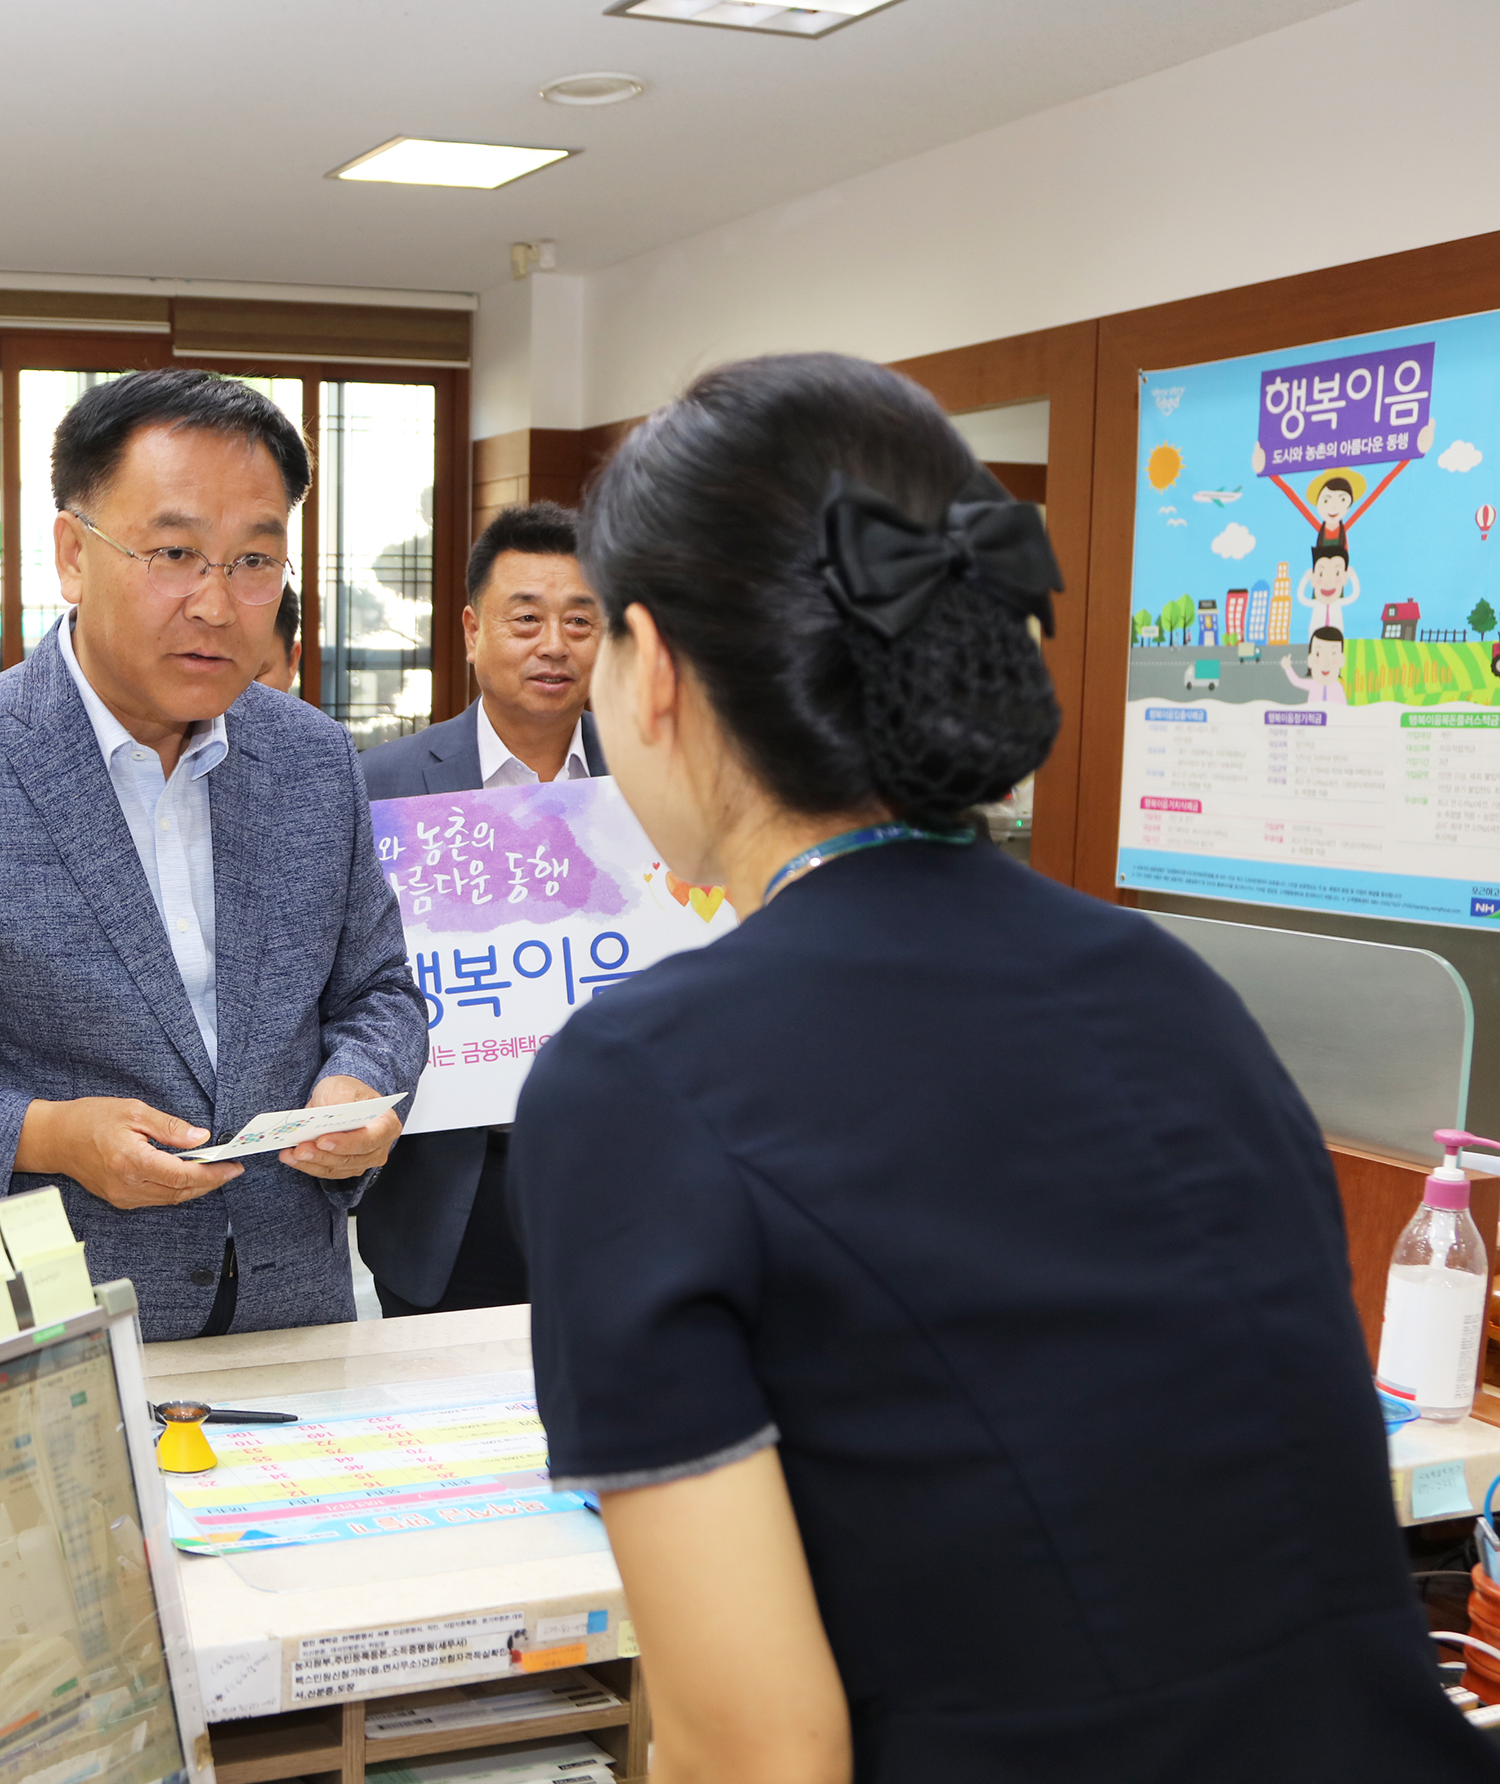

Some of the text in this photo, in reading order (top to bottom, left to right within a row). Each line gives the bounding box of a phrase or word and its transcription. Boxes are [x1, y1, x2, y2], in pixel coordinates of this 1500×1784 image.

[1265, 360, 1429, 440] 행복이음
[1272, 432, 1409, 465] 도시와 농촌의 아름다운 동행
[416, 806, 495, 866] 농촌의
[505, 845, 570, 904] 동행
[1475, 903, 1495, 913] NH
[426, 1044, 457, 1068] 는
[226, 1431, 256, 1439] 106
[307, 1431, 336, 1439] 149
[354, 1472, 375, 1480] 15
[437, 1498, 548, 1523] 목적자금
[349, 1512, 434, 1536] 만들기
